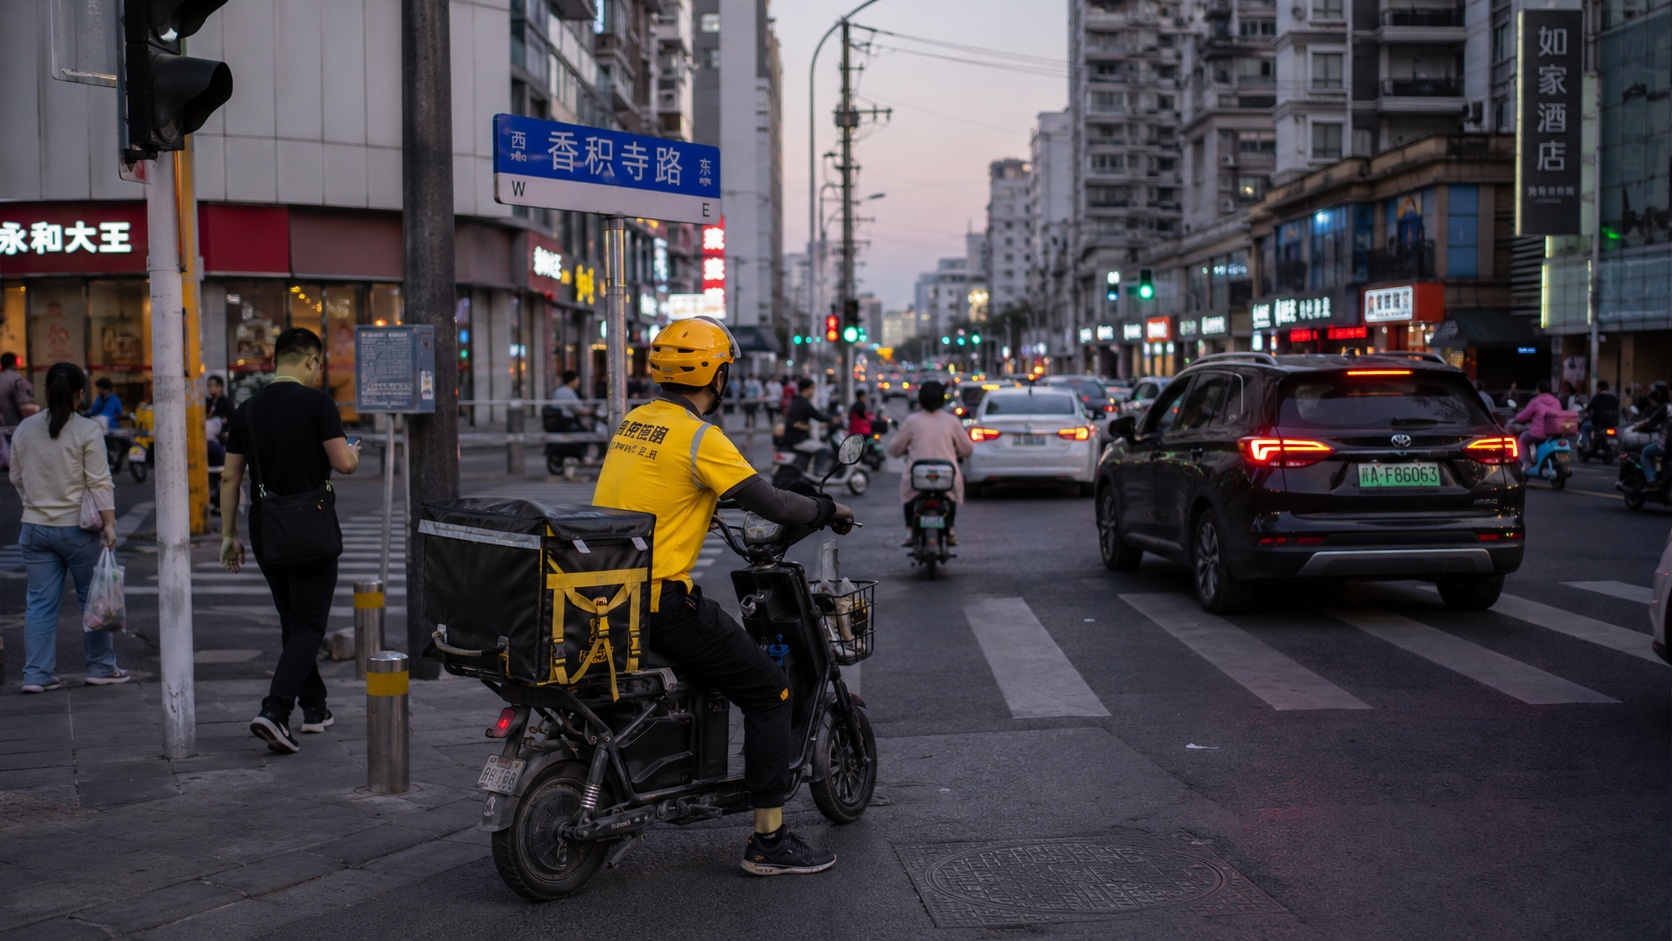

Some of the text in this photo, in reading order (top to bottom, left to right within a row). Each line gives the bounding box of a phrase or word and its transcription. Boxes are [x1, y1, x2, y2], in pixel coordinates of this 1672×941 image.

[1537, 26, 1568, 172] 如家酒店
[511, 131, 526, 150] 西
[547, 131, 682, 186] 香积寺路
[699, 158, 711, 175] 东
[511, 180, 710, 217] W E
[0, 220, 133, 256] 永和大王
